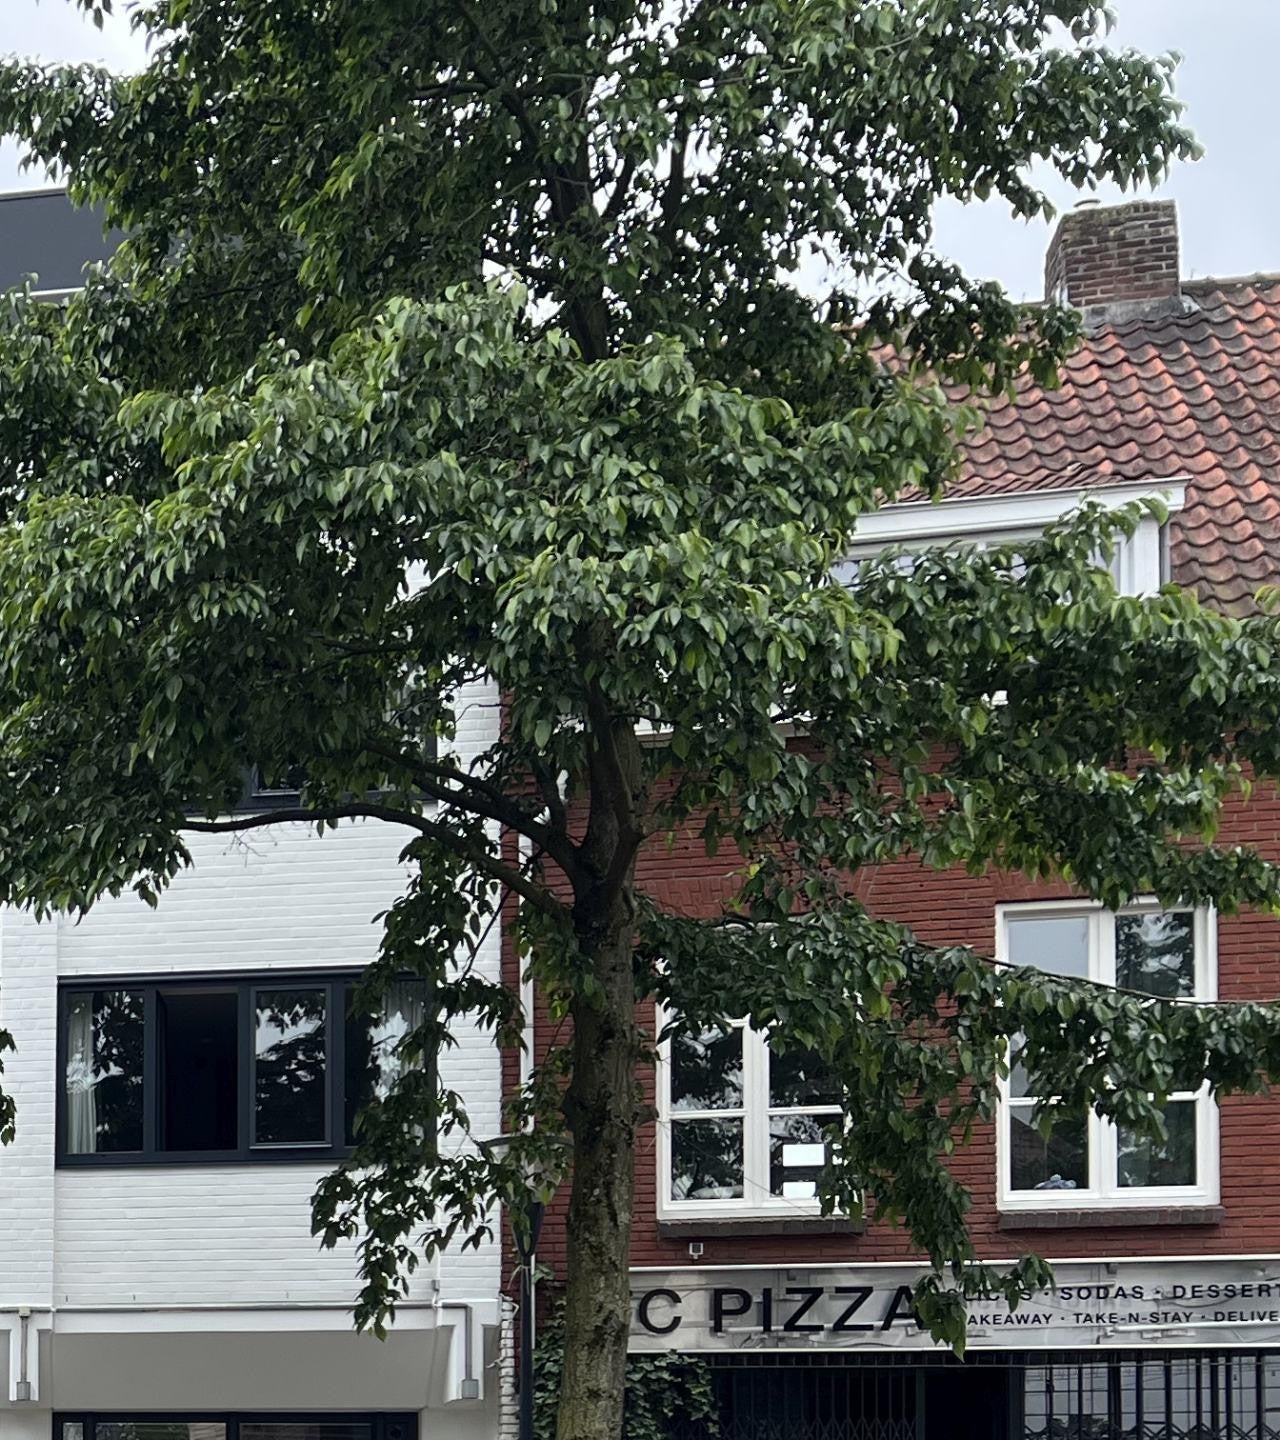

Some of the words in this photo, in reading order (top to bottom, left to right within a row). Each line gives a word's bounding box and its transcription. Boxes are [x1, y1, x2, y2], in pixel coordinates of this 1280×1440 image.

[1060, 1286, 1145, 1300] SODAS
[629, 1288, 682, 1334] C
[713, 1285, 927, 1332] PIZZA
[967, 1313, 1053, 1325] AKEAWAY
[1073, 1311, 1193, 1324] TAKE-N-STAY
